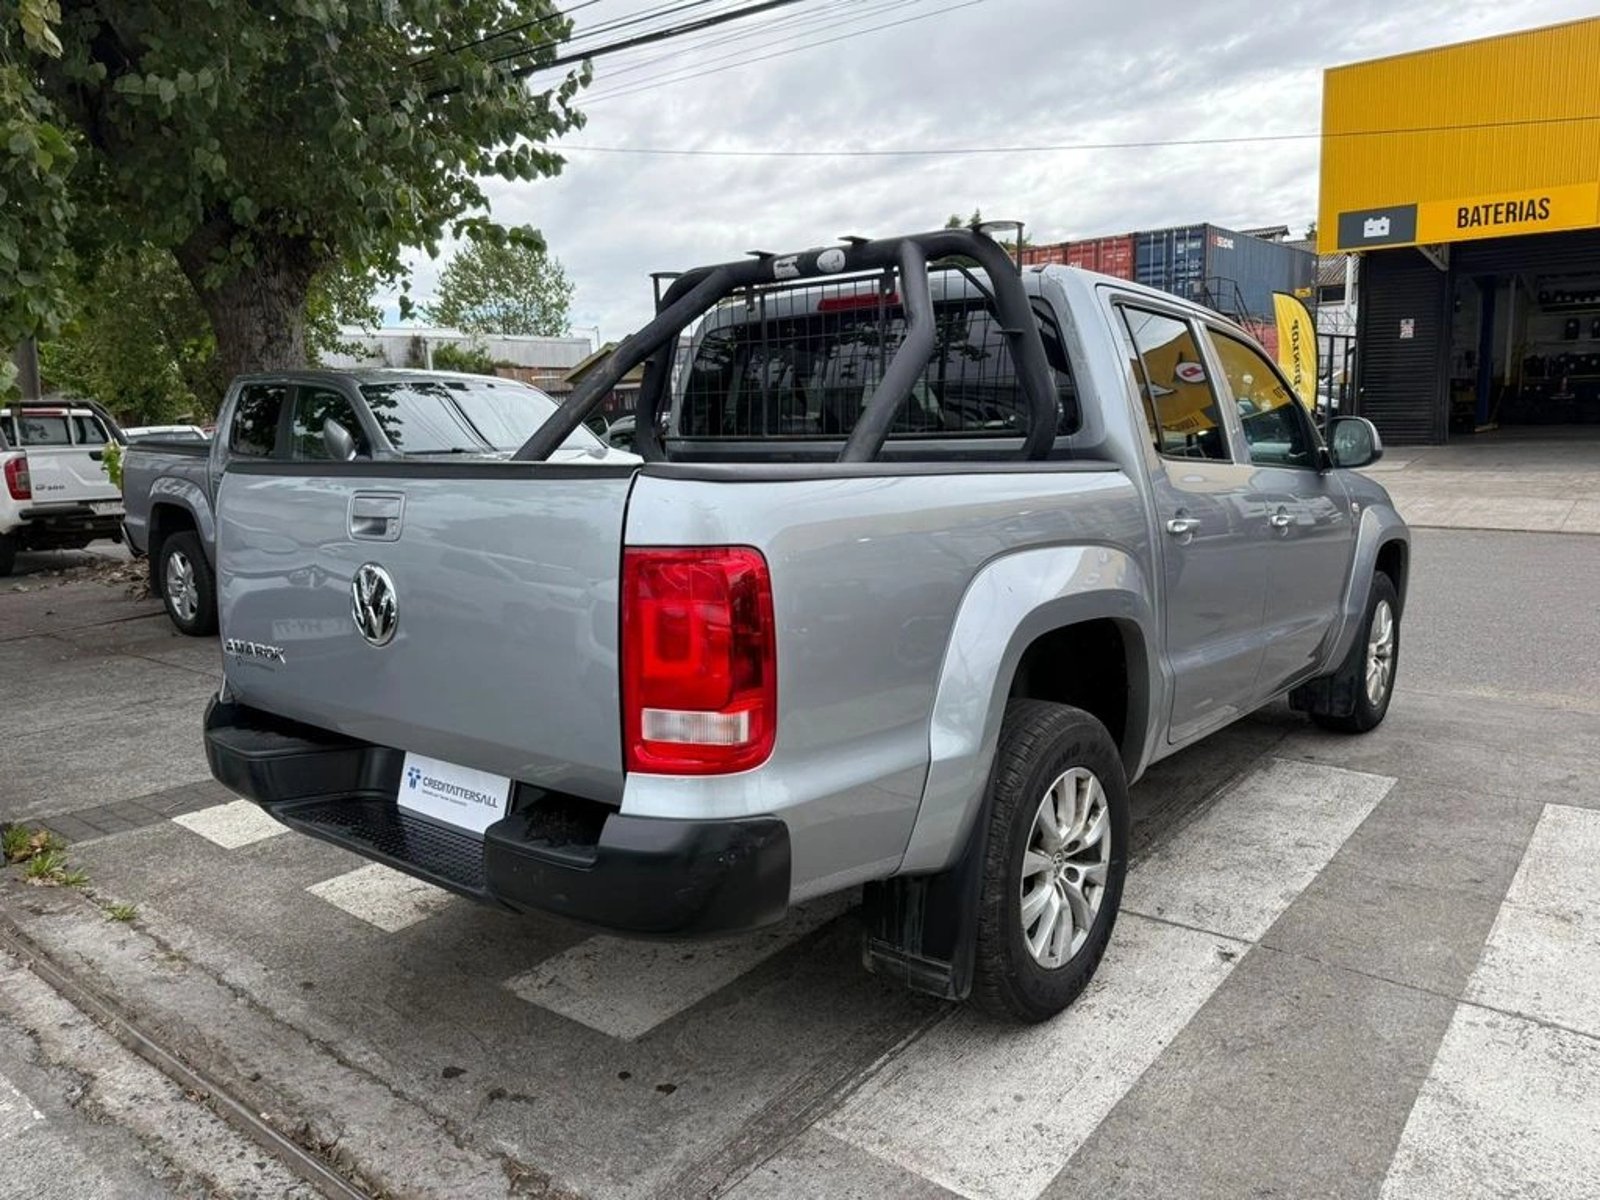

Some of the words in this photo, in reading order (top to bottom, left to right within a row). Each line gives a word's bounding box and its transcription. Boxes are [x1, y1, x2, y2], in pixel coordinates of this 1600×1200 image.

[1456, 197, 1551, 228] BATERIAS
[226, 638, 286, 663] AMAROK
[422, 776, 499, 808] CREDITATTERSALL
